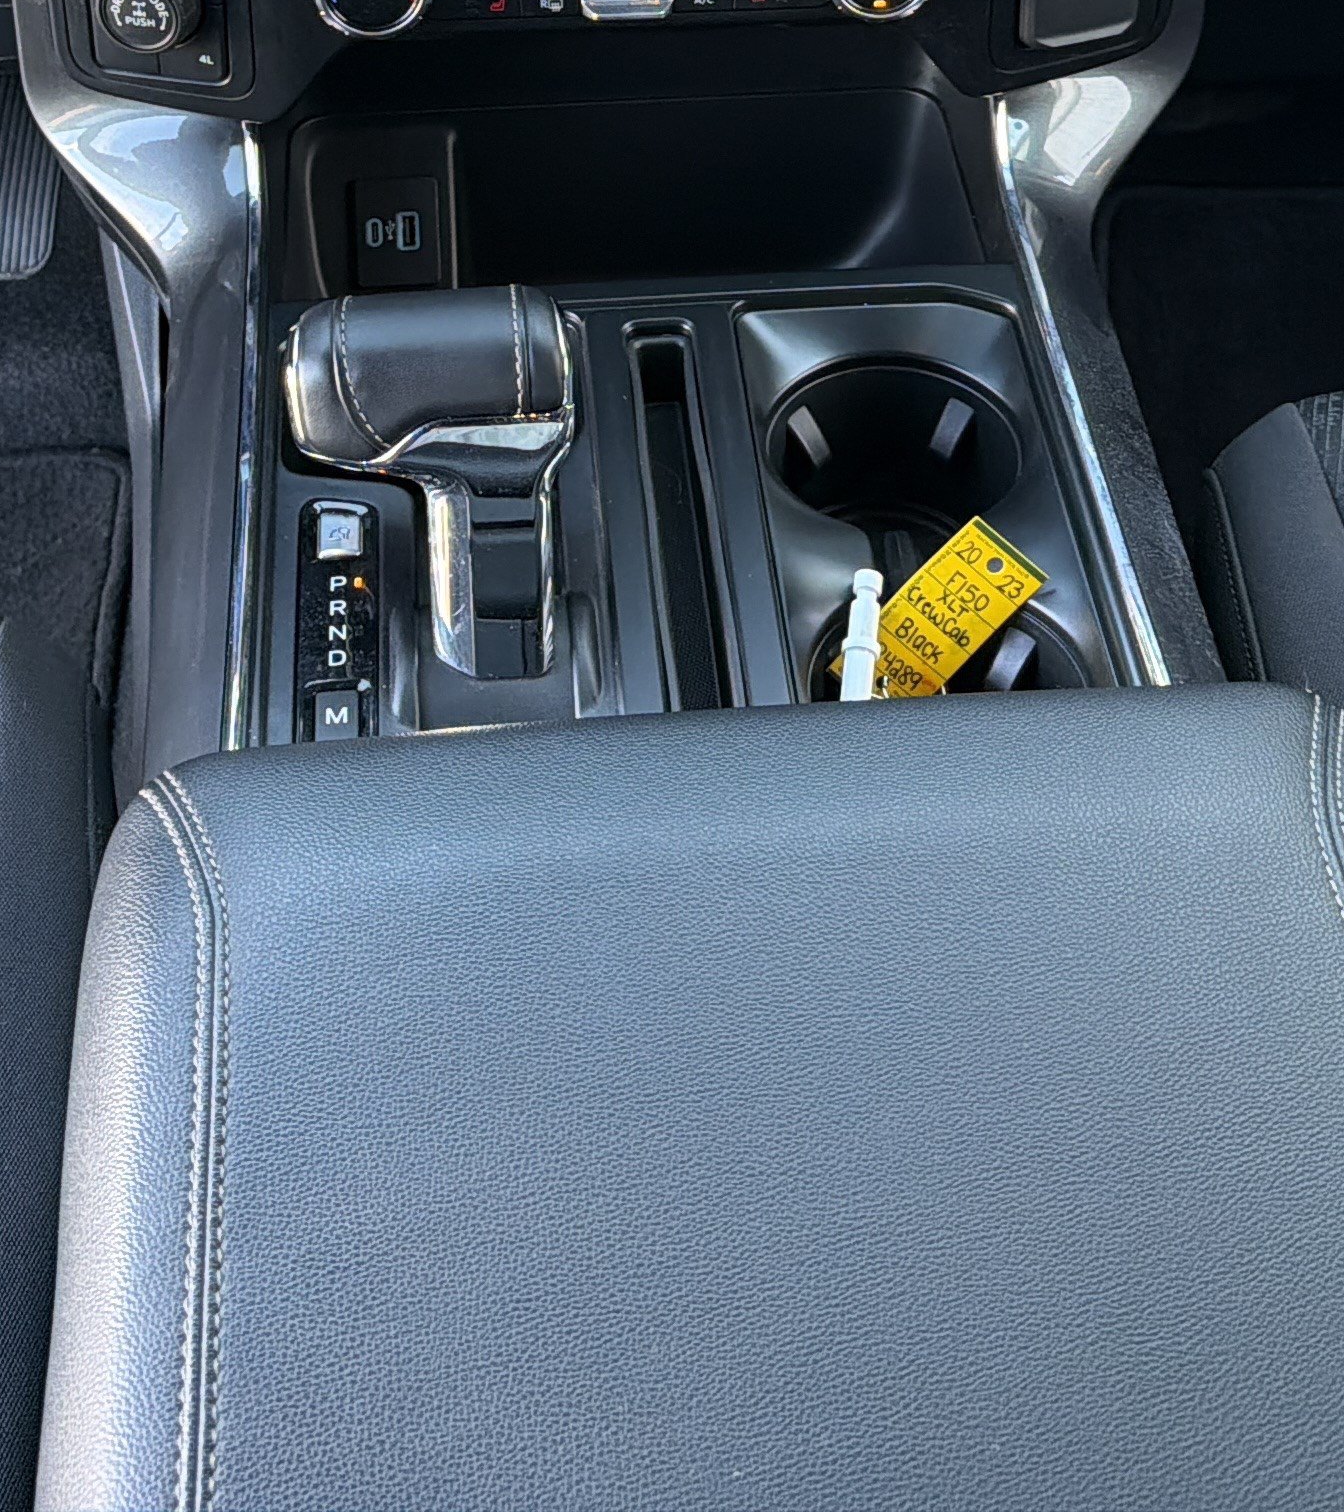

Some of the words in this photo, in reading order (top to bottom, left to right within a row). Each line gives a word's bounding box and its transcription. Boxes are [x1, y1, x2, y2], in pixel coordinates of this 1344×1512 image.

[125, 16, 156, 27] PUSH
[199, 55, 214, 65] 4L
[956, 541, 982, 565] 20
[330, 576, 347, 592] P
[946, 570, 990, 612] F150
[996, 575, 1024, 599] 23
[329, 600, 347, 616] R
[935, 588, 969, 617] XLT
[328, 626, 347, 641] N
[895, 617, 944, 664] Black
[328, 651, 347, 666] D
[325, 706, 348, 724] M
